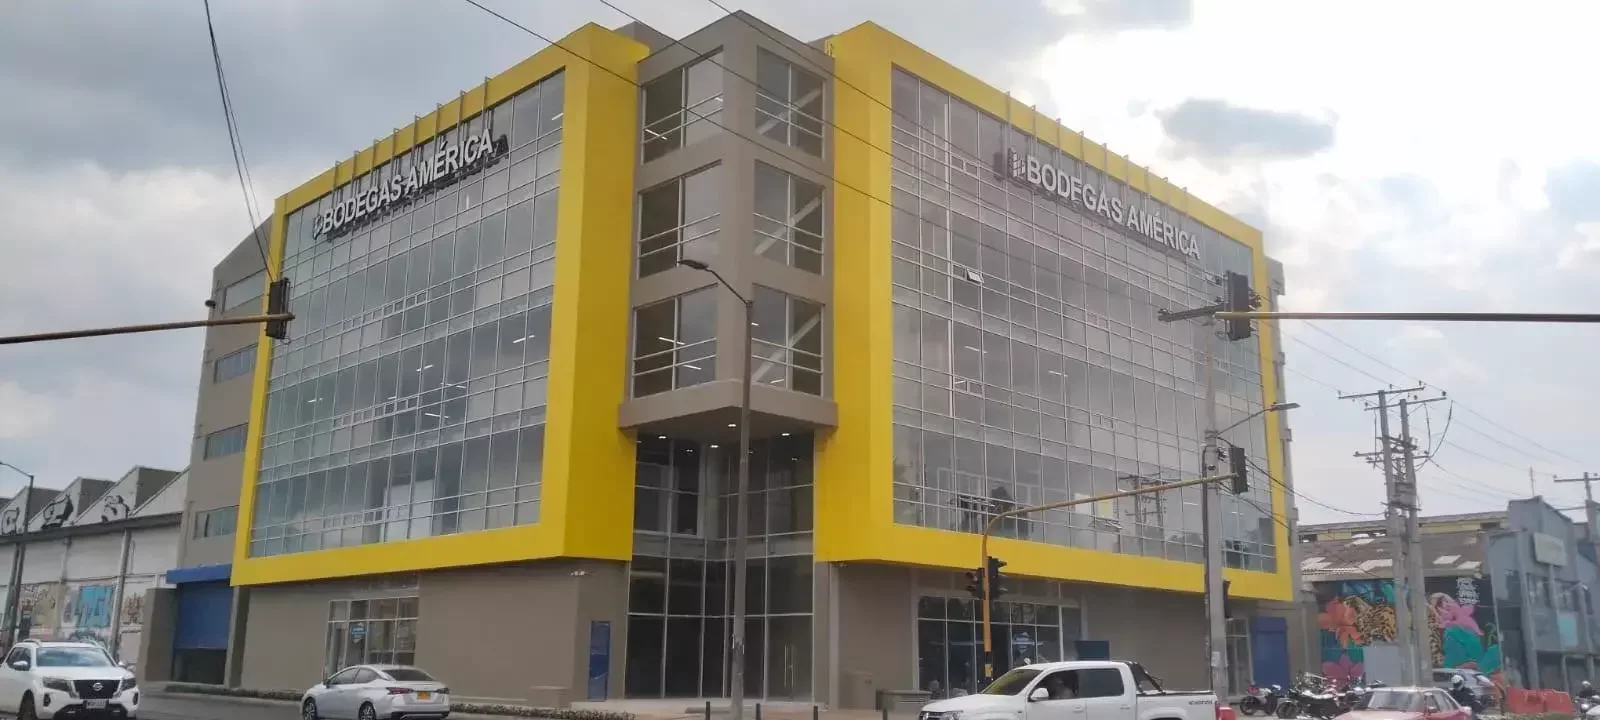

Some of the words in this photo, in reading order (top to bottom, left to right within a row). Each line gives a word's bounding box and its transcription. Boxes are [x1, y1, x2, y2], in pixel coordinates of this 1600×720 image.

[322, 174, 402, 234] BODEGAS
[404, 128, 493, 195] AMÉRICA
[1026, 155, 1124, 223] BODEGAS
[1126, 205, 1201, 260] AMÉRICA
